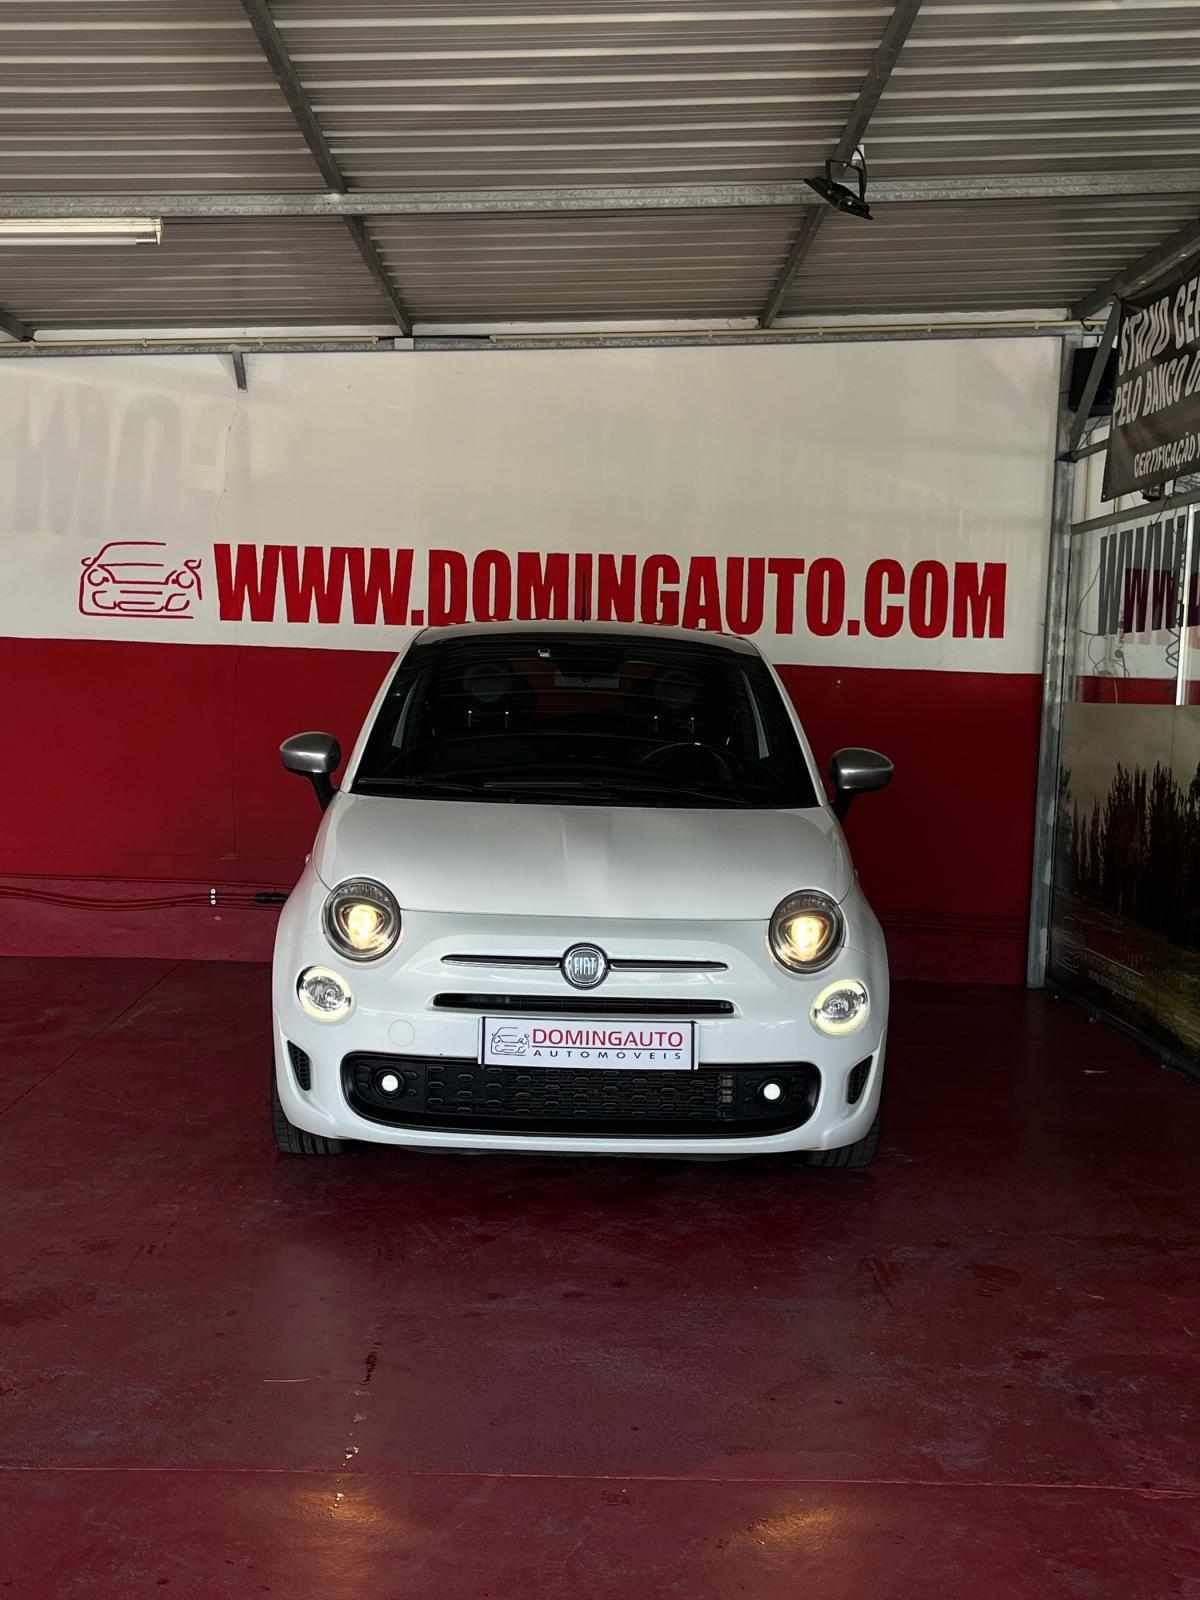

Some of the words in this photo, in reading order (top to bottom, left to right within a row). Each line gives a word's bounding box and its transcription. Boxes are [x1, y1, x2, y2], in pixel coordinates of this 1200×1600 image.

[1119, 297, 1170, 376] STAND
[1113, 375, 1142, 428] PELO
[1142, 355, 1189, 416] BANCO
[1134, 432, 1194, 476] CERTIFICAÇÃO
[213, 543, 1006, 638] WWW.DOMINGAUTO.COM
[574, 957, 596, 976] FIAT
[532, 1028, 683, 1048] DOMINGAUTO
